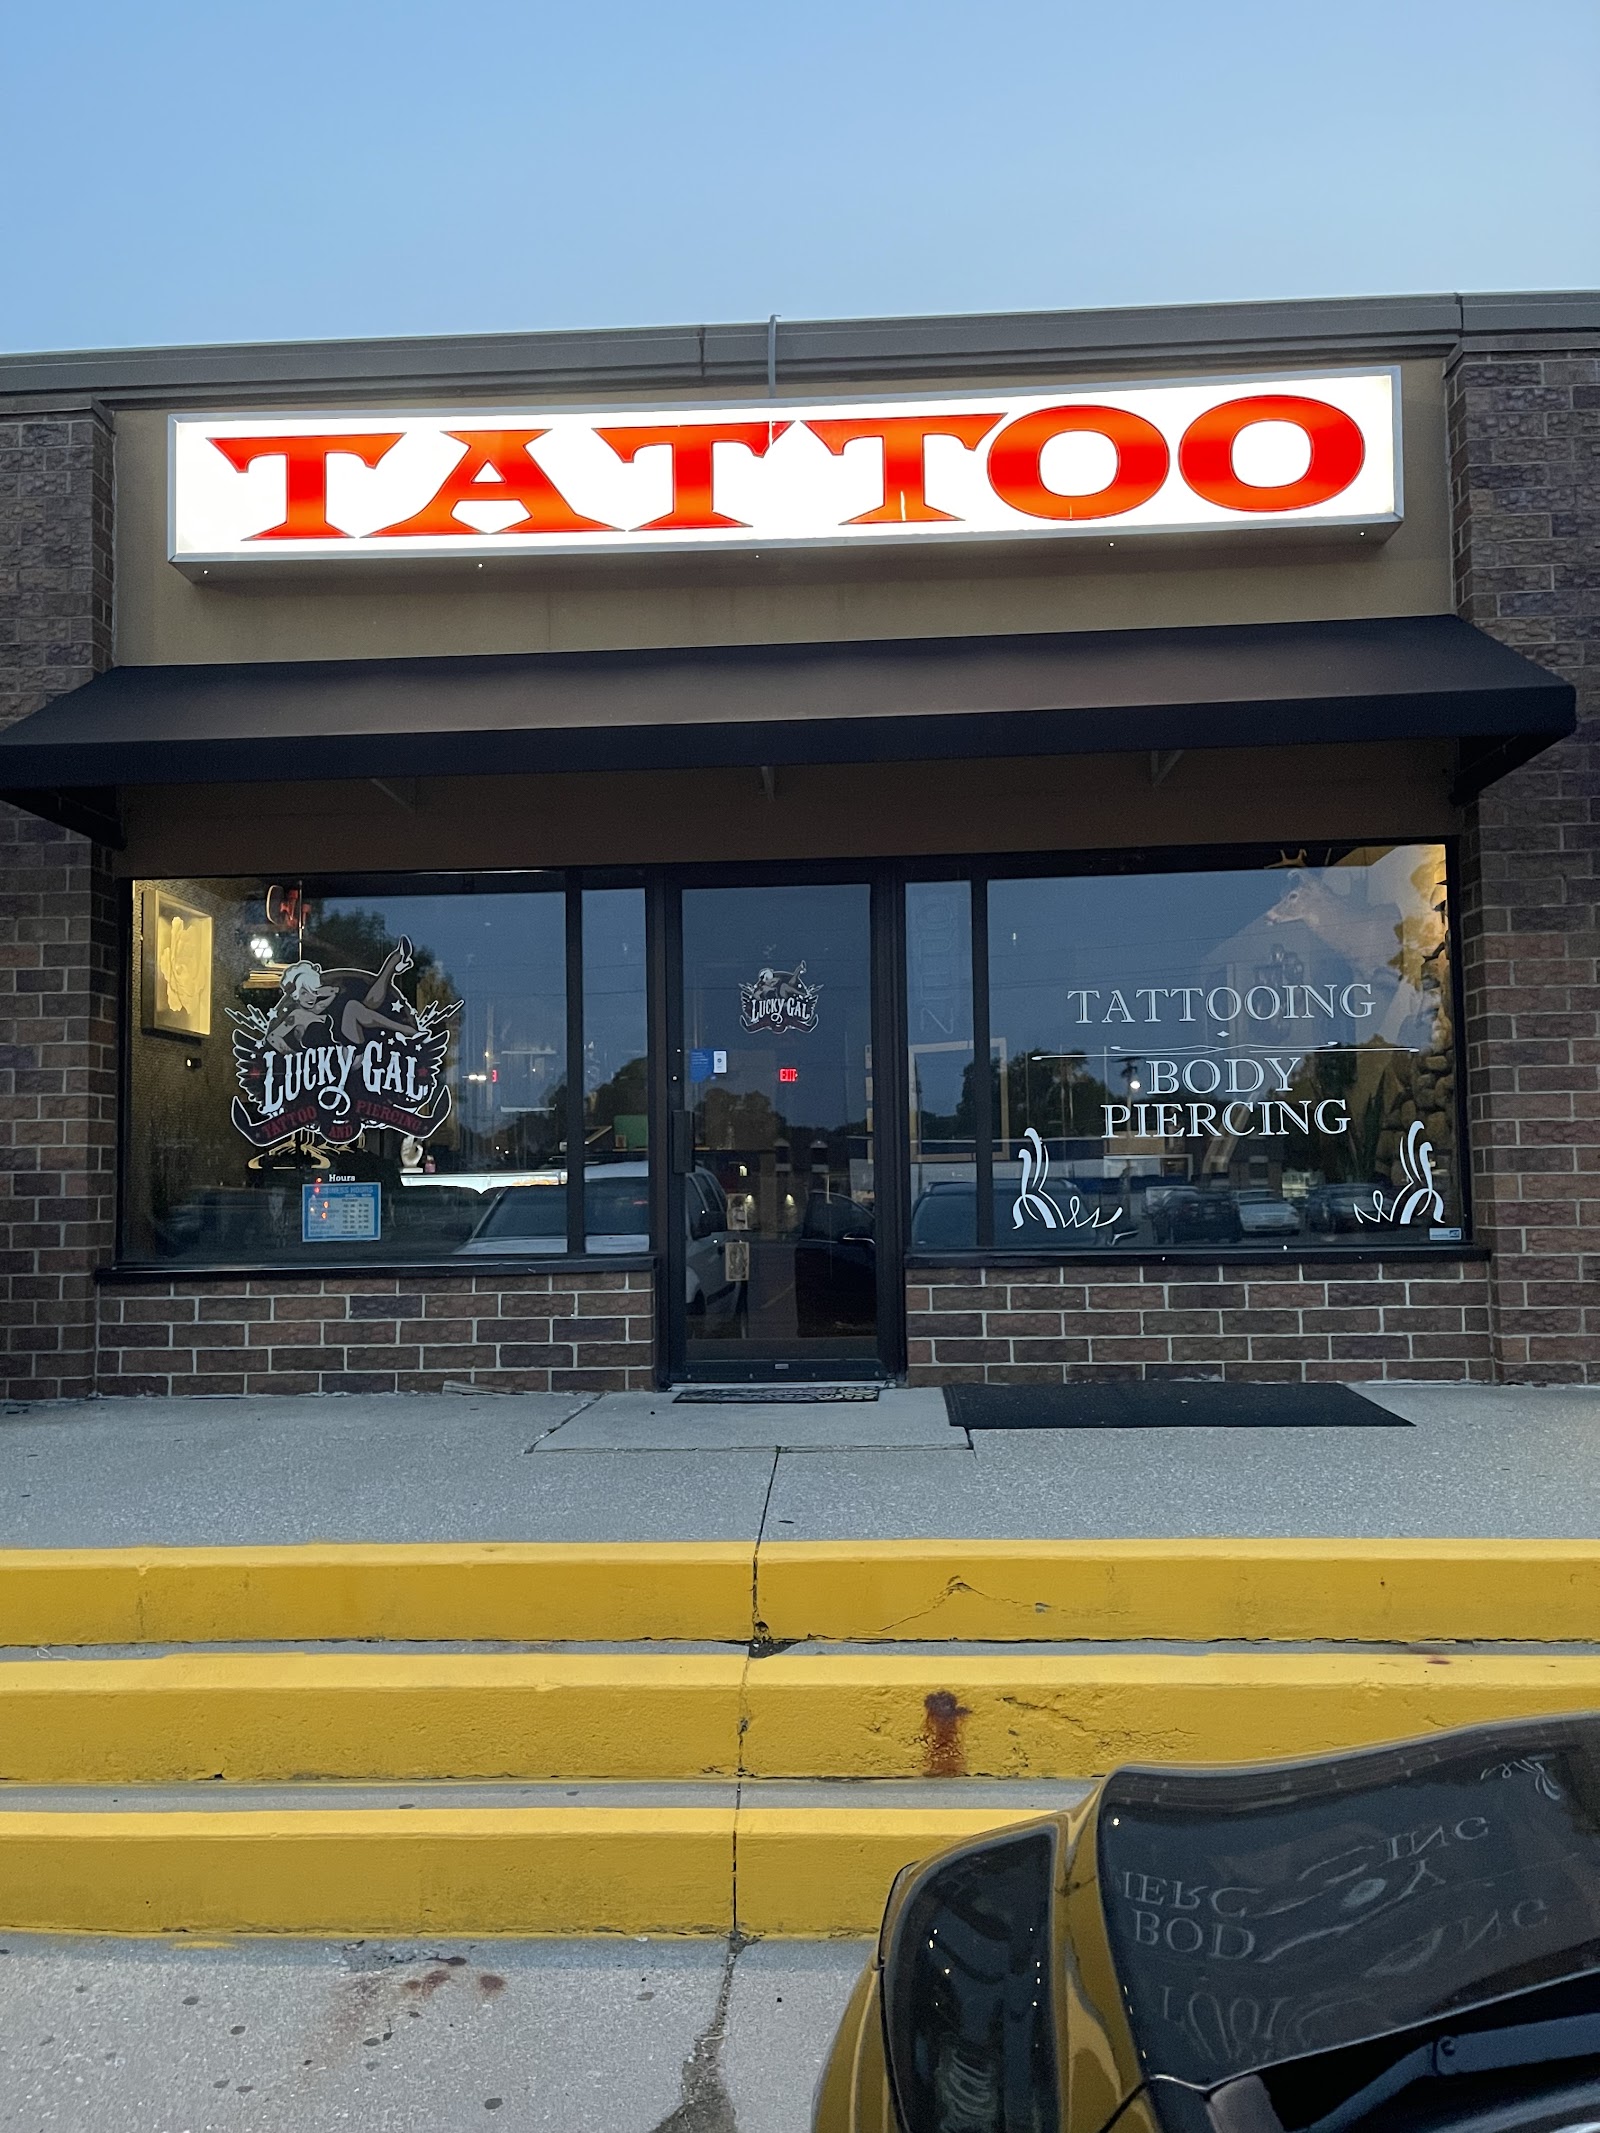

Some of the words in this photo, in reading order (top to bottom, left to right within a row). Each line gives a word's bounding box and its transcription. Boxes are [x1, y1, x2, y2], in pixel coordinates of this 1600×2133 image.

[205, 394, 1366, 541] TATTOO
[751, 997, 785, 1024] LUCKY
[787, 996, 811, 1020] GAL
[1067, 983, 1377, 1024] TATTOOING
[262, 1044, 357, 1116] LUCKY
[361, 1040, 428, 1101] GAL
[1145, 1056, 1302, 1095] BODY
[262, 1105, 317, 1138] TATTOO
[329, 1123, 353, 1138] AND
[355, 1100, 422, 1131] PIERCING
[1100, 1098, 1352, 1139] PIERCING
[328, 1173, 356, 1182] Hours
